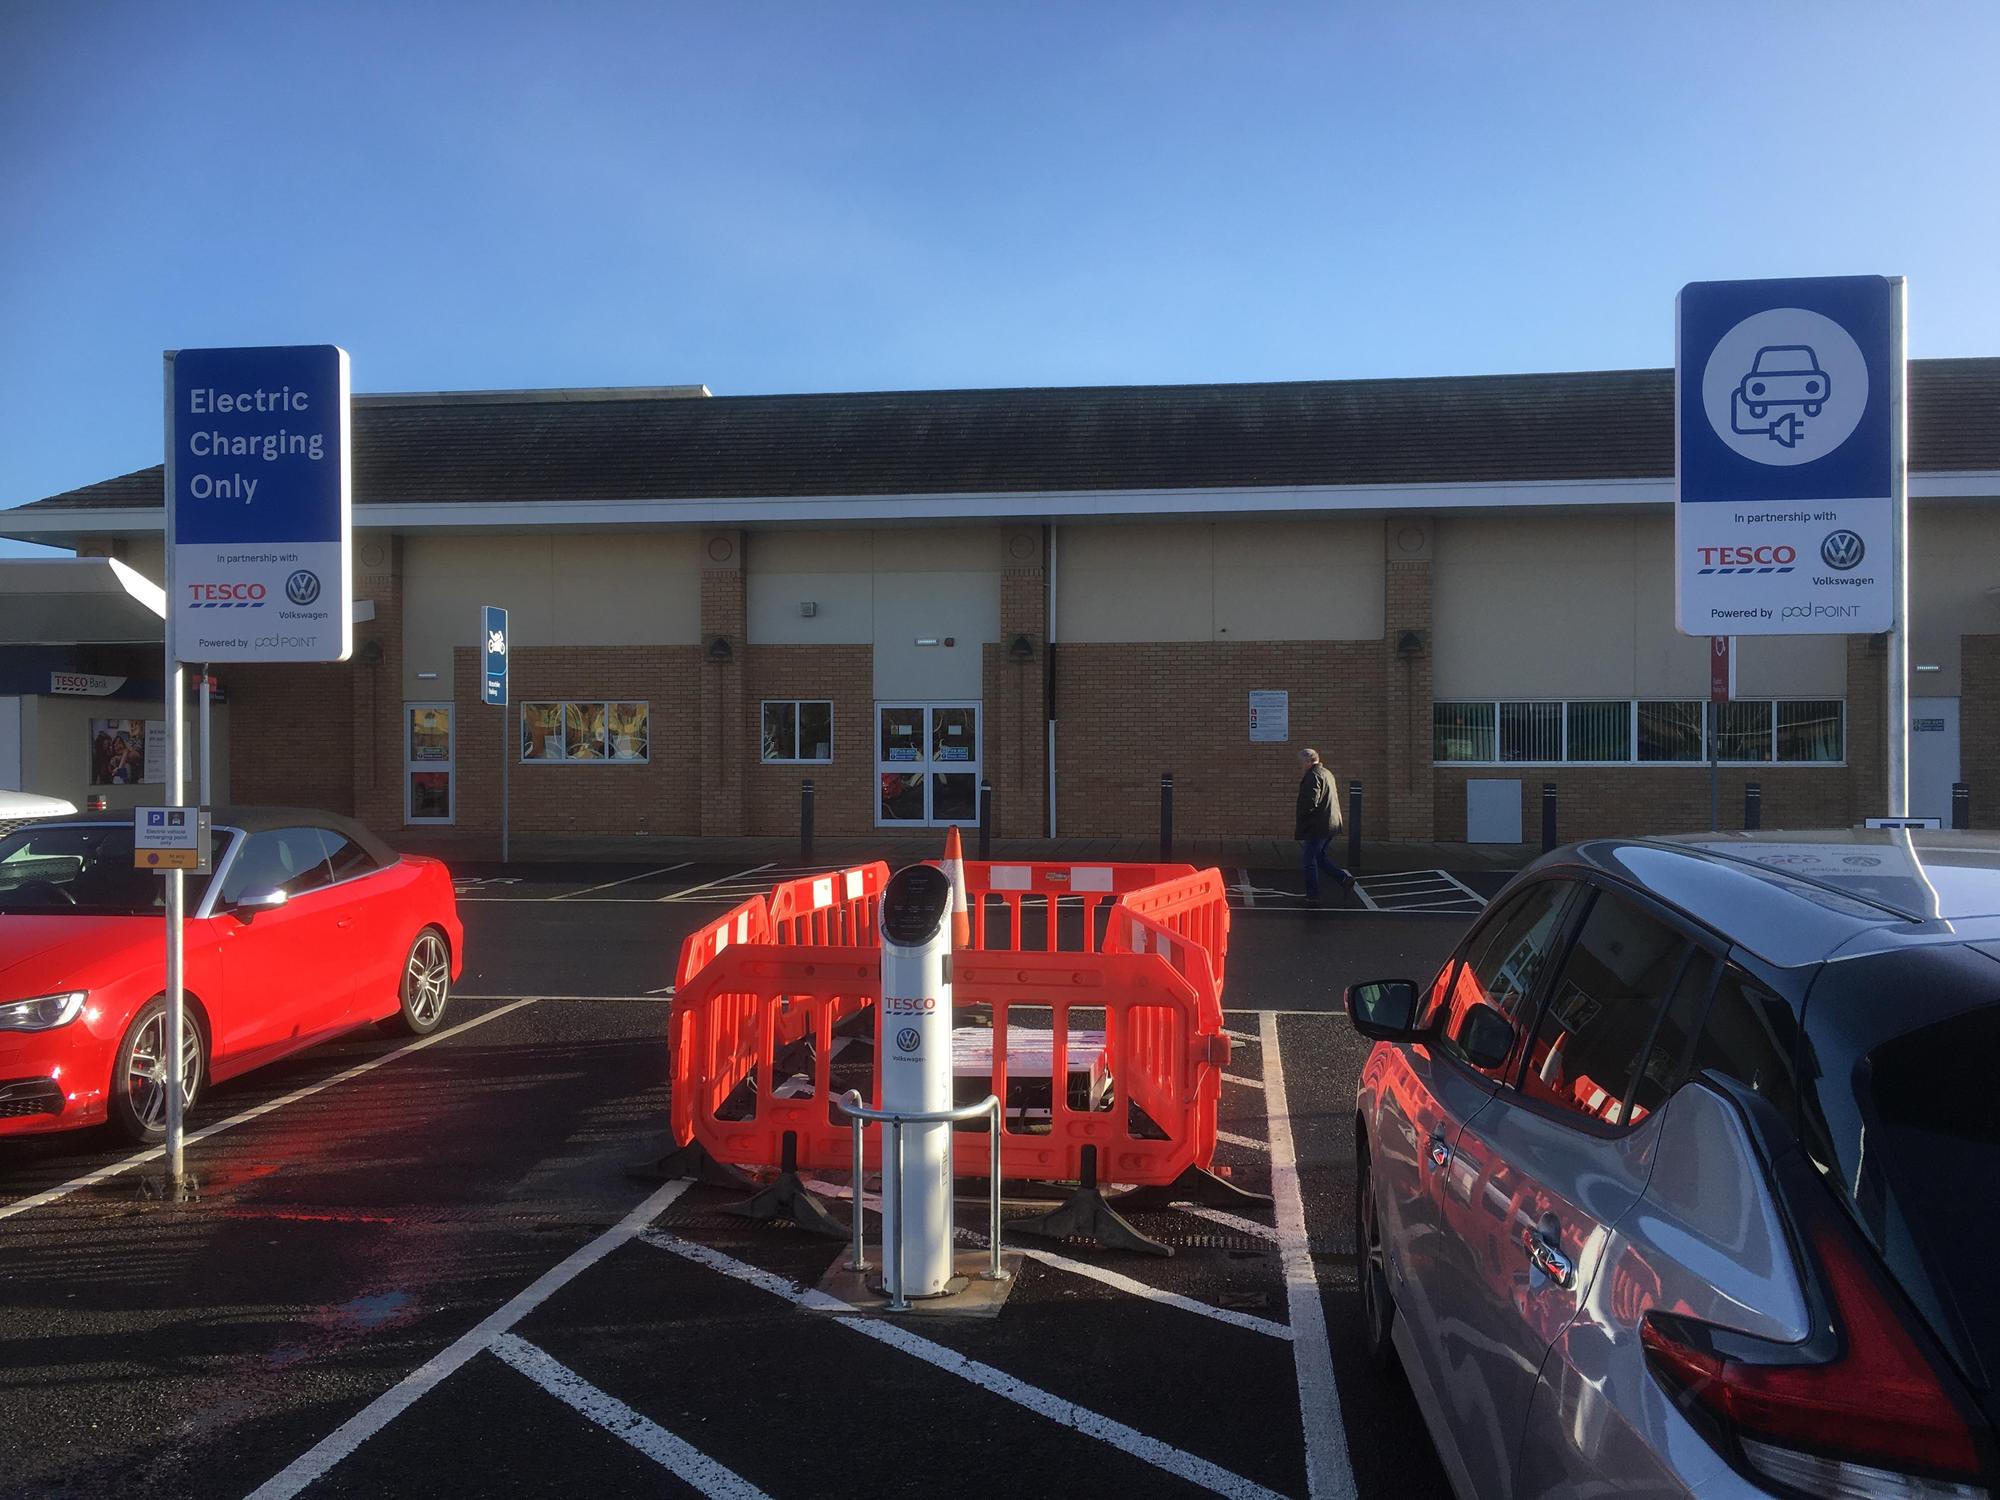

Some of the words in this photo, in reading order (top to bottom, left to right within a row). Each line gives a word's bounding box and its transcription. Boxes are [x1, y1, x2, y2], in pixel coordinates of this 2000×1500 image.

[190, 386, 309, 414] Electric
[190, 429, 324, 461] Charging
[190, 473, 258, 505] Only
[1734, 513, 1745, 523] In
[1747, 512, 1811, 525] partnership
[1814, 511, 1837, 522] with
[216, 554, 225, 563] In
[226, 553, 278, 565] partnership
[279, 553, 298, 563] with
[1697, 545, 1796, 566] TESCO
[1812, 577, 1875, 587] Volkswagen
[188, 583, 267, 601] TESCO
[278, 611, 329, 621] Volkswagen
[1711, 608, 1758, 619] Powered
[1760, 608, 1774, 620] by
[1814, 605, 1861, 618] POINT
[199, 638, 236, 648] Powered
[237, 638, 249, 649] by
[280, 636, 318, 648] POINT
[55, 676, 88, 688] TESCO
[89, 677, 108, 689] Bank
[885, 997, 936, 1011] TESCO
[892, 1055, 928, 1064] Volkswagen
